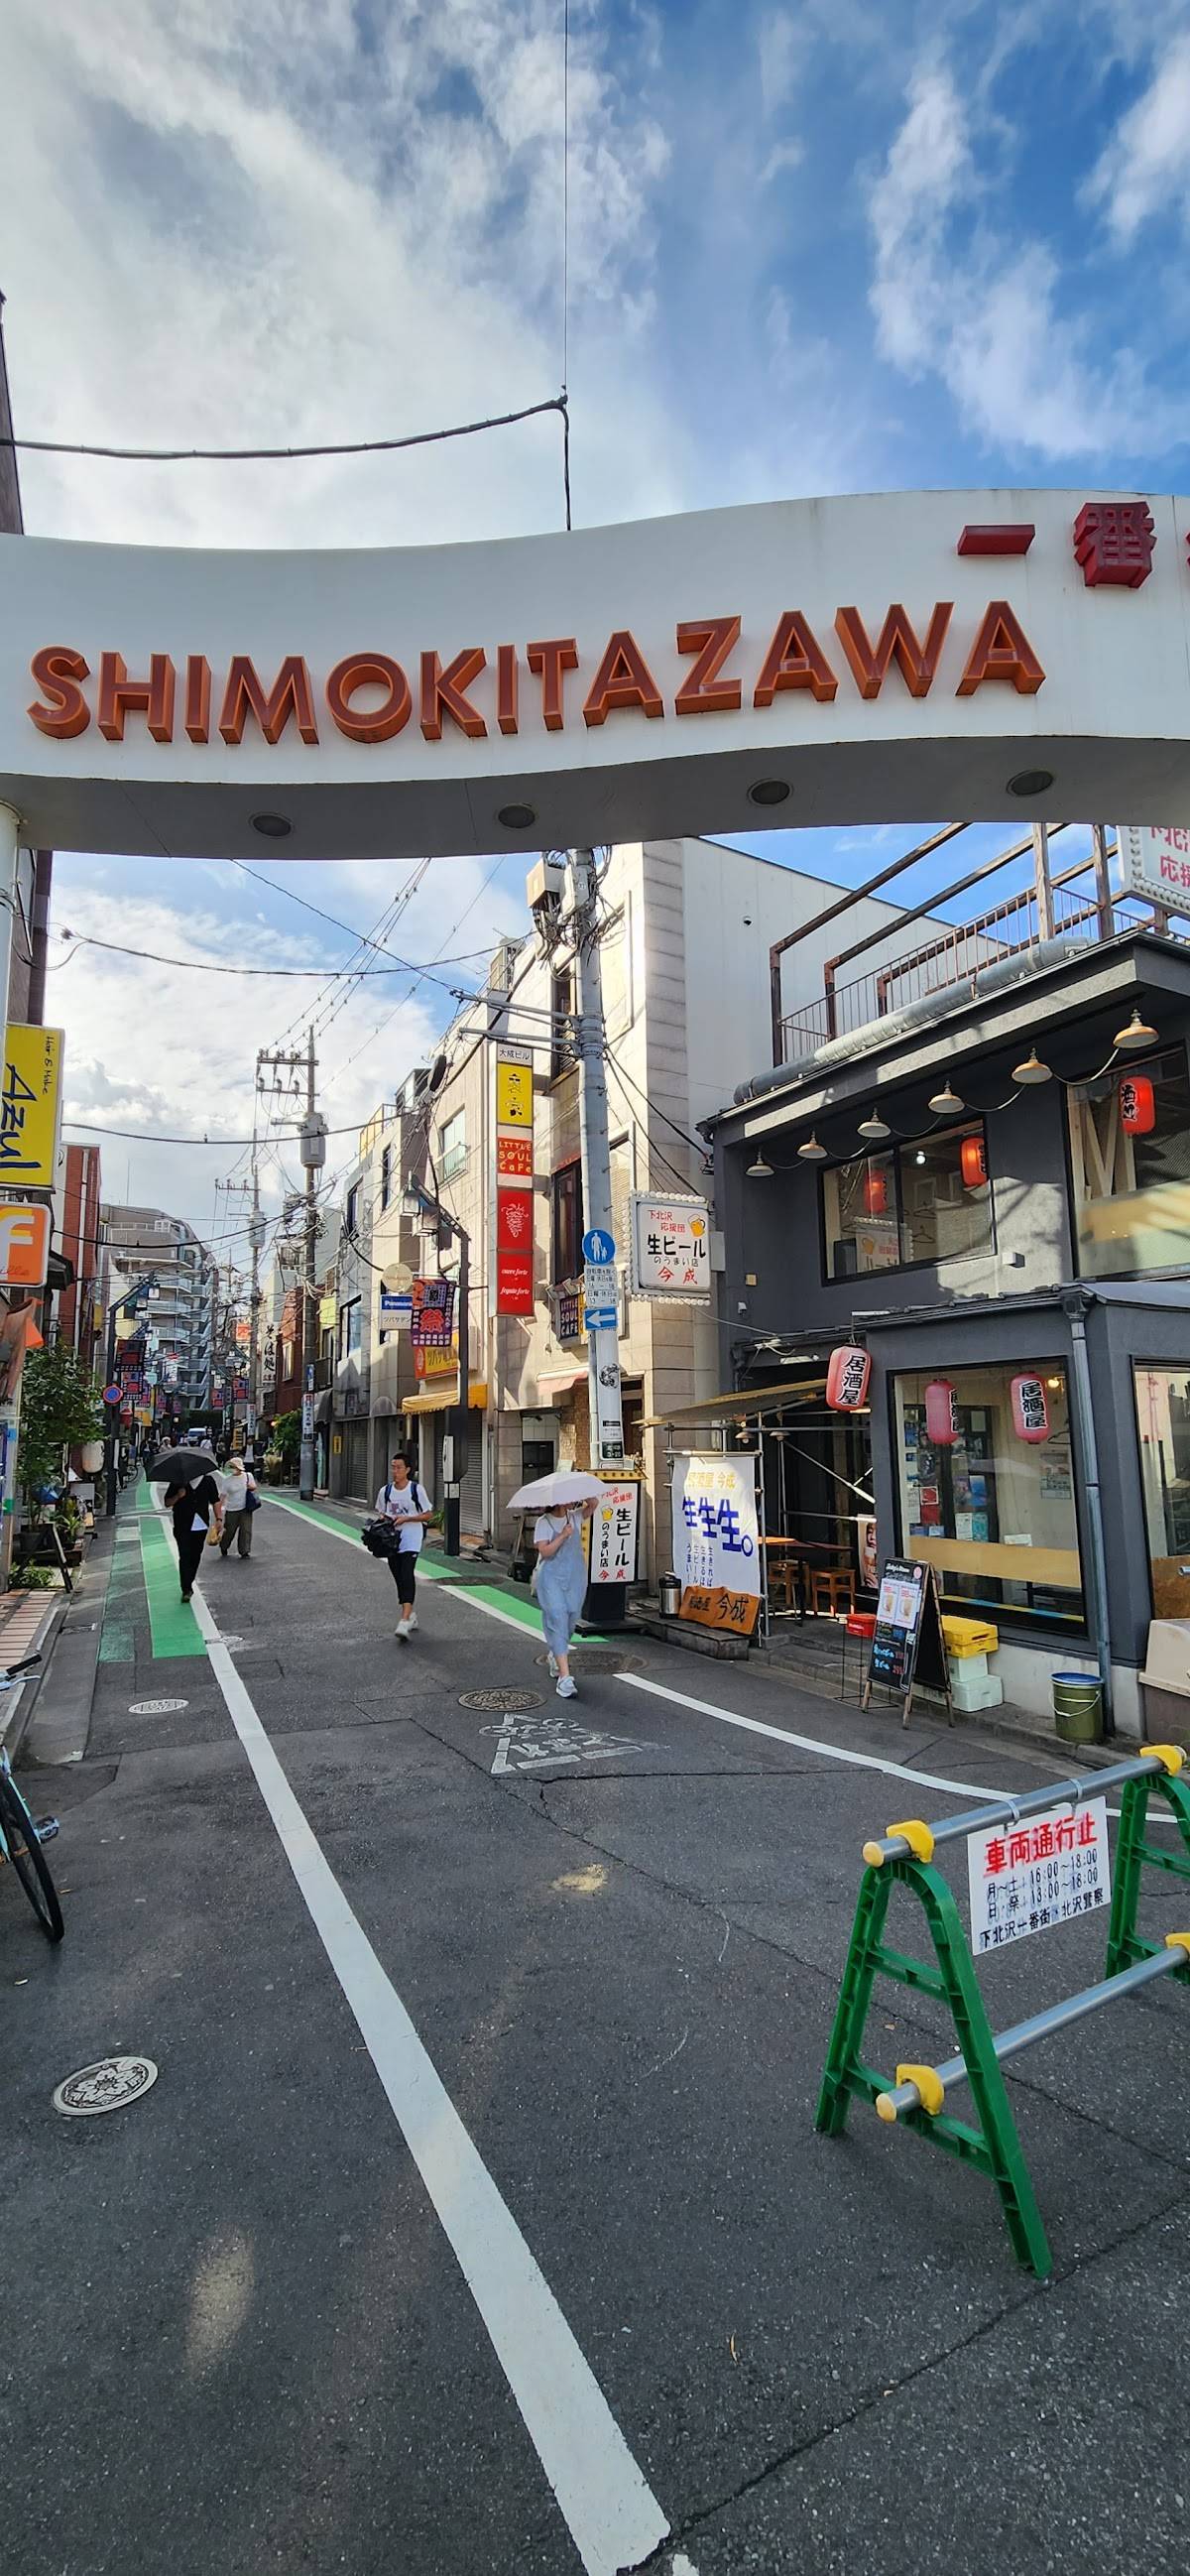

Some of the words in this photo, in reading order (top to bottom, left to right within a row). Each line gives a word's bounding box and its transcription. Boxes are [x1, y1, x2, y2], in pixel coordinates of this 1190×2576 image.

[958, 501, 1190, 588] 一番
[27, 601, 1046, 746] SHIMOKITAZAWA
[0, 1062, 42, 1168] Azul
[498, 1151, 532, 1163] SOUL
[499, 1141, 532, 1152] LITTLE
[648, 1210, 673, 1221] 下北沢
[660, 1222, 685, 1233] 応援団
[648, 1233, 706, 1258] 生ビール
[654, 1256, 699, 1268] のうまい店
[561, 1297, 578, 1311] LITTLE
[561, 1309, 578, 1323] SOUL
[561, 1322, 578, 1336] CAFE
[837, 1355, 866, 1406] 居酒屋
[1021, 1381, 1048, 1428] 居酒屋
[600, 1523, 610, 1567] のうまい店
[615, 1508, 632, 1566] 生ビール
[716, 1593, 750, 1623] 今成
[985, 1811, 1098, 1875] 車両通行止
